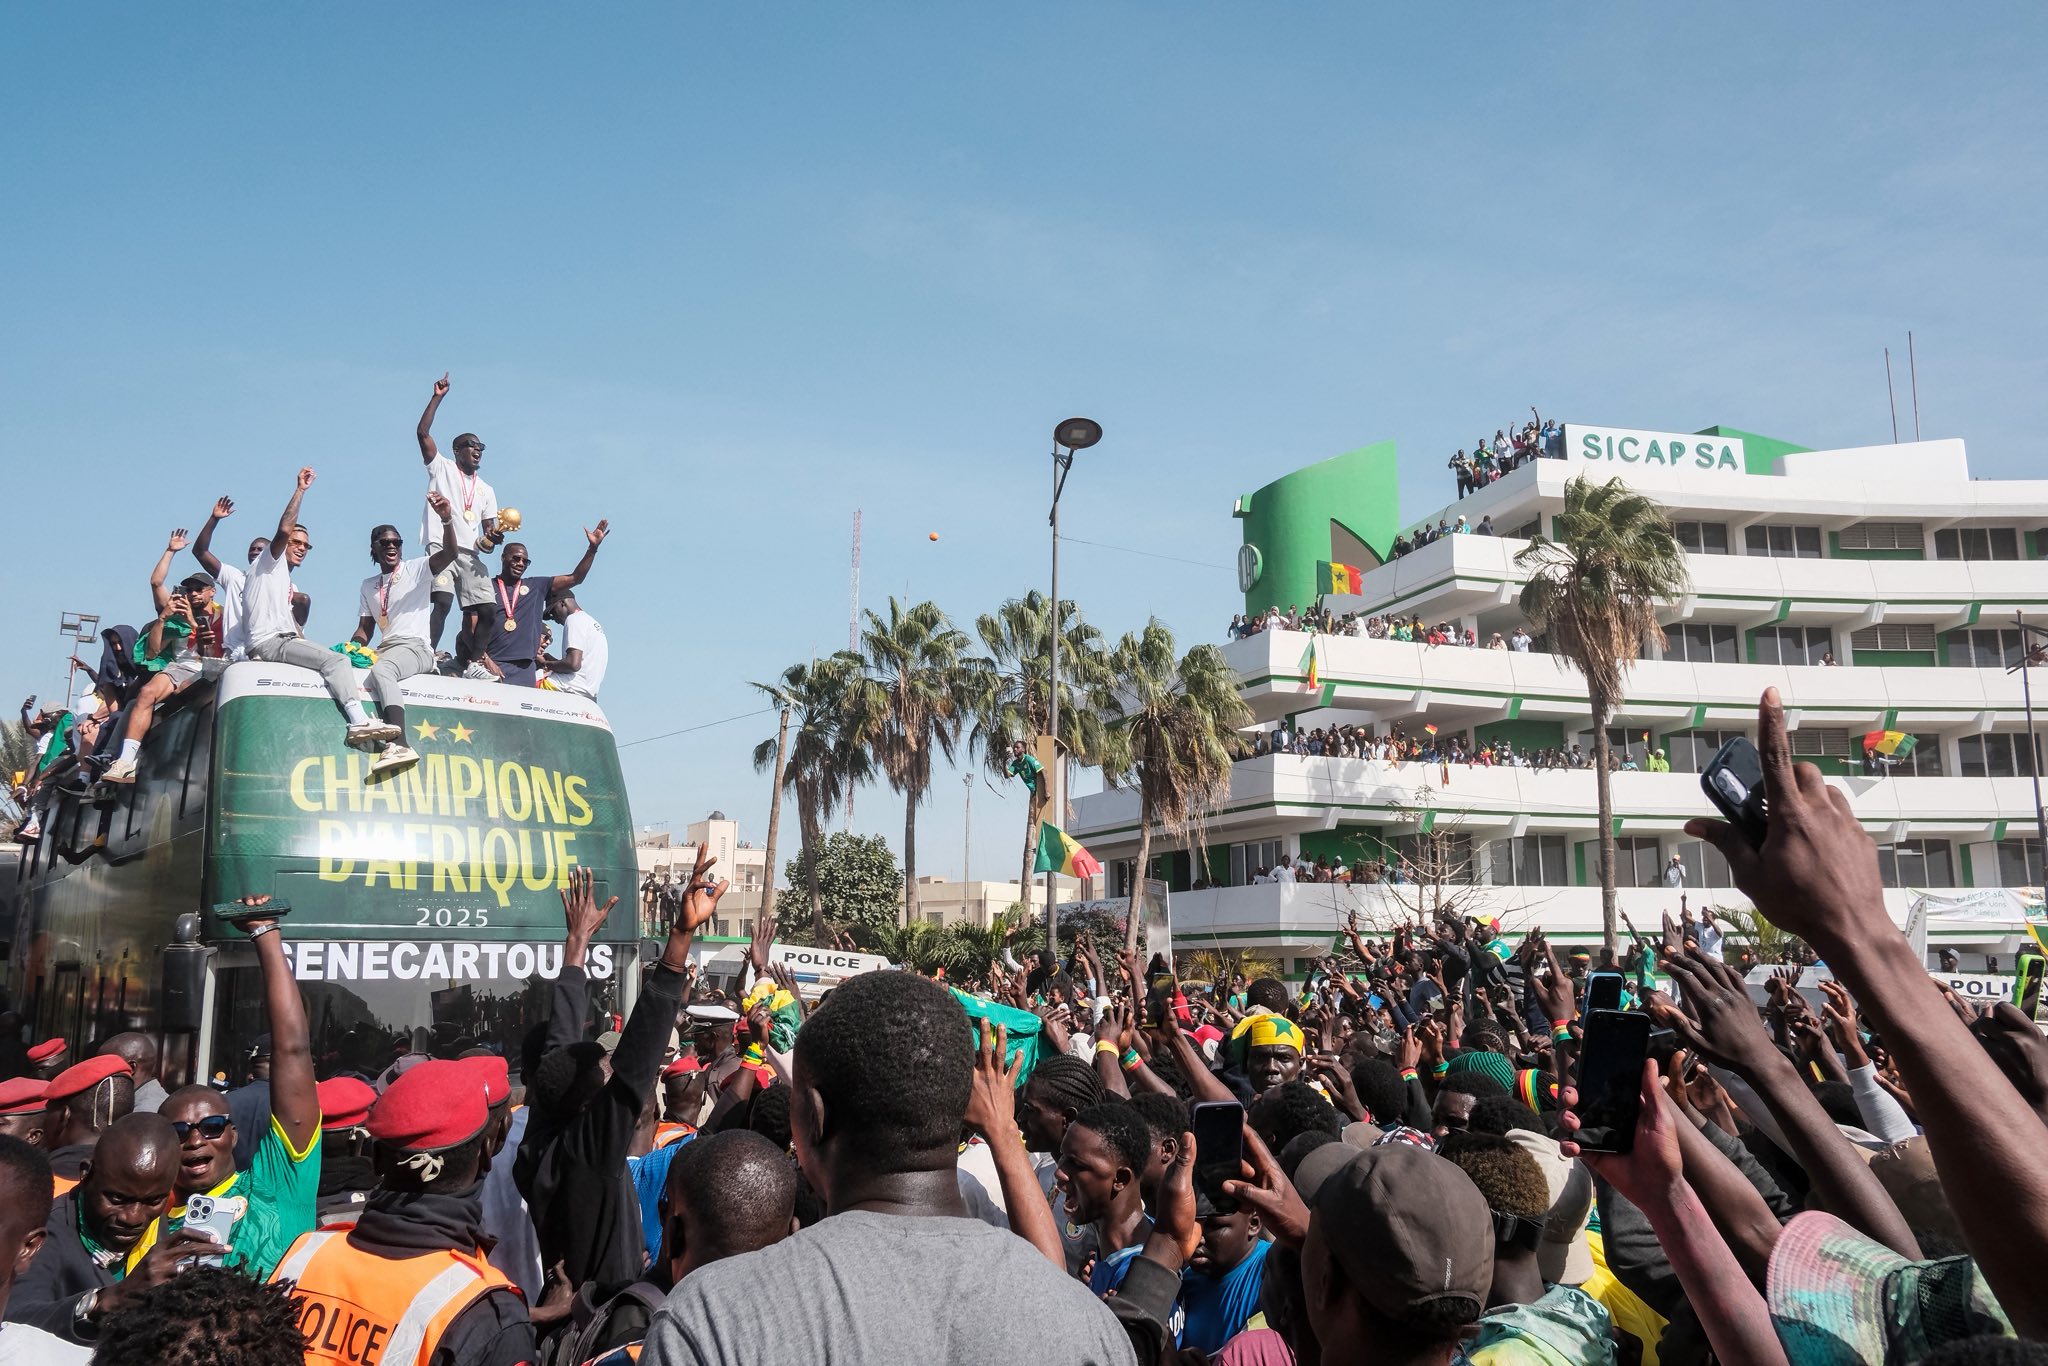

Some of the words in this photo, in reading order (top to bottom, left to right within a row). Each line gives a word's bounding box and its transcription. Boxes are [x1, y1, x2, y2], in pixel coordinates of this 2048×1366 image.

[1583, 433, 1686, 466] SICAP
[1695, 442, 1738, 471] SA
[290, 753, 594, 827] CHAMPIONS
[318, 818, 579, 908] D'AFRIQUE
[416, 907, 489, 928] 2025
[784, 952, 860, 969] POLICE
[300, 1302, 388, 1366] OLICE
